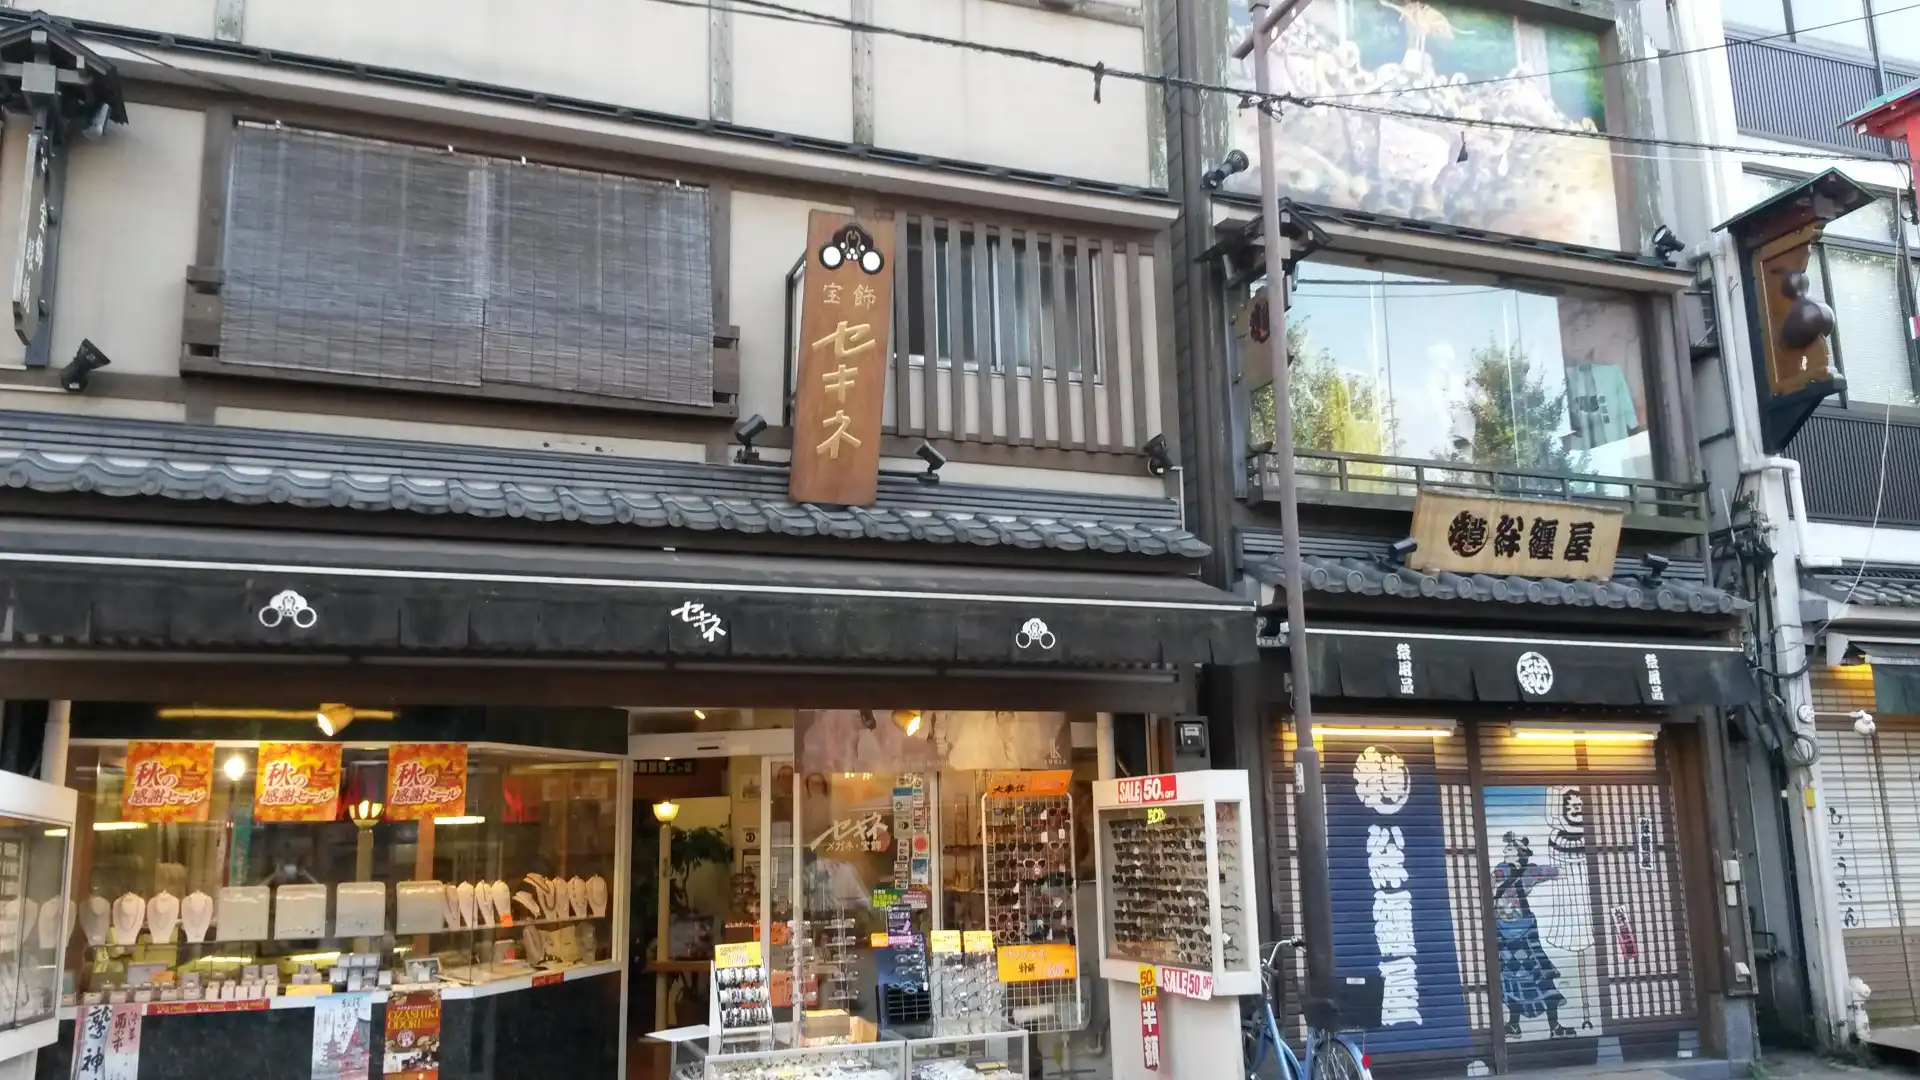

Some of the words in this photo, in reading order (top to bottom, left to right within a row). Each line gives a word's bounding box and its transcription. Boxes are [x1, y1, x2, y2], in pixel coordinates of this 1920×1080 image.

[822, 282, 877, 311] 宝飾
[811, 321, 876, 460] セキネ
[671, 601, 727, 642] セキネ
[134, 761, 178, 788] 秋の
[266, 761, 308, 788] 秋の
[394, 761, 437, 788] 秋の
[129, 788, 207, 806] 感謝セール
[260, 787, 335, 806] 感謝セール
[391, 786, 463, 806] 感謝セール
[1119, 780, 1141, 803] SALE
[1165, 790, 1175, 799] OFF
[809, 811, 888, 852] セキネ
[1827, 806, 1860, 928] ひょうたん
[1141, 986, 1155, 996] OFF
[1163, 969, 1187, 994] SALE
[1203, 976, 1213, 990] OFF
[387, 1006, 440, 1020] OZASHIKI
[387, 1018, 422, 1030] ODORI
[80, 1005, 114, 1080] 鷲神
[1142, 1001, 1160, 1067] 半額
